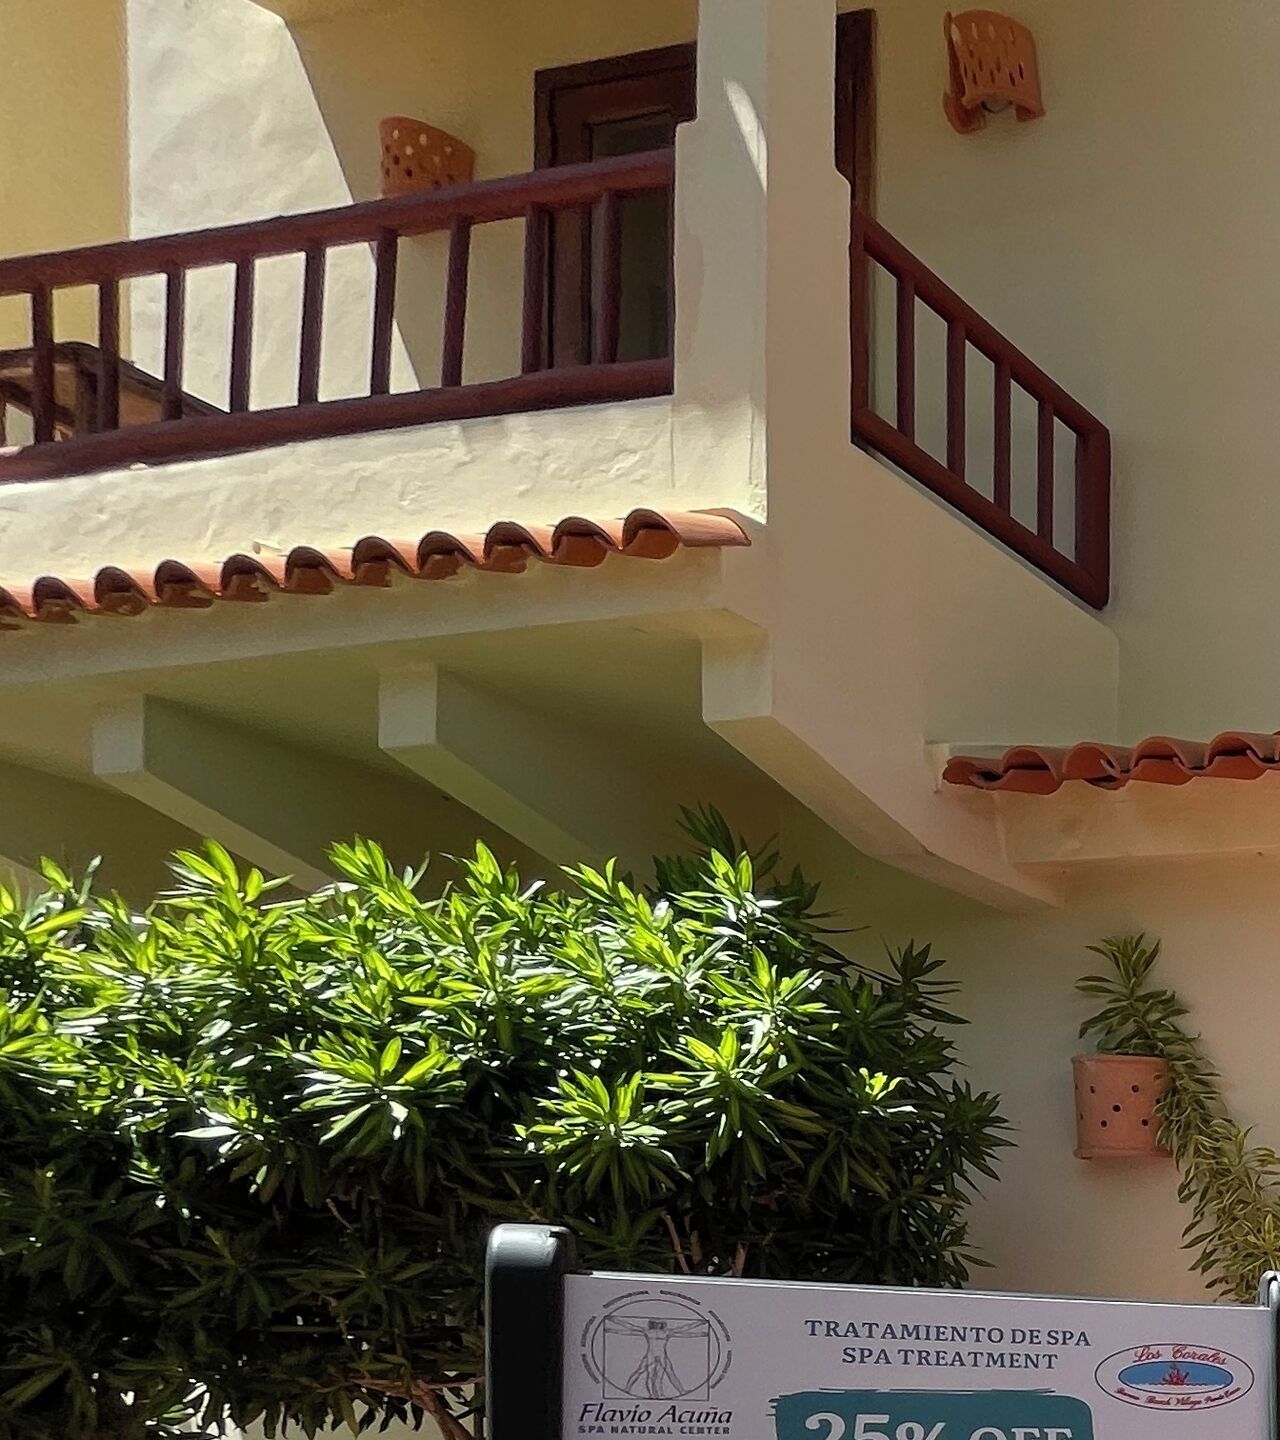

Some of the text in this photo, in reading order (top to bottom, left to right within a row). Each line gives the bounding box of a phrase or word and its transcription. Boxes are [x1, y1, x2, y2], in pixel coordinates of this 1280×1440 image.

[805, 1320, 1092, 1347] TRATAMIENTO DE SPA
[842, 1347, 1058, 1369] SPA TREATMENT
[1133, 1345, 1227, 1365] Los Corales
[578, 1403, 733, 1424] Flavio Acuña
[578, 1425, 730, 1435] SPA NATURAL CENTER
